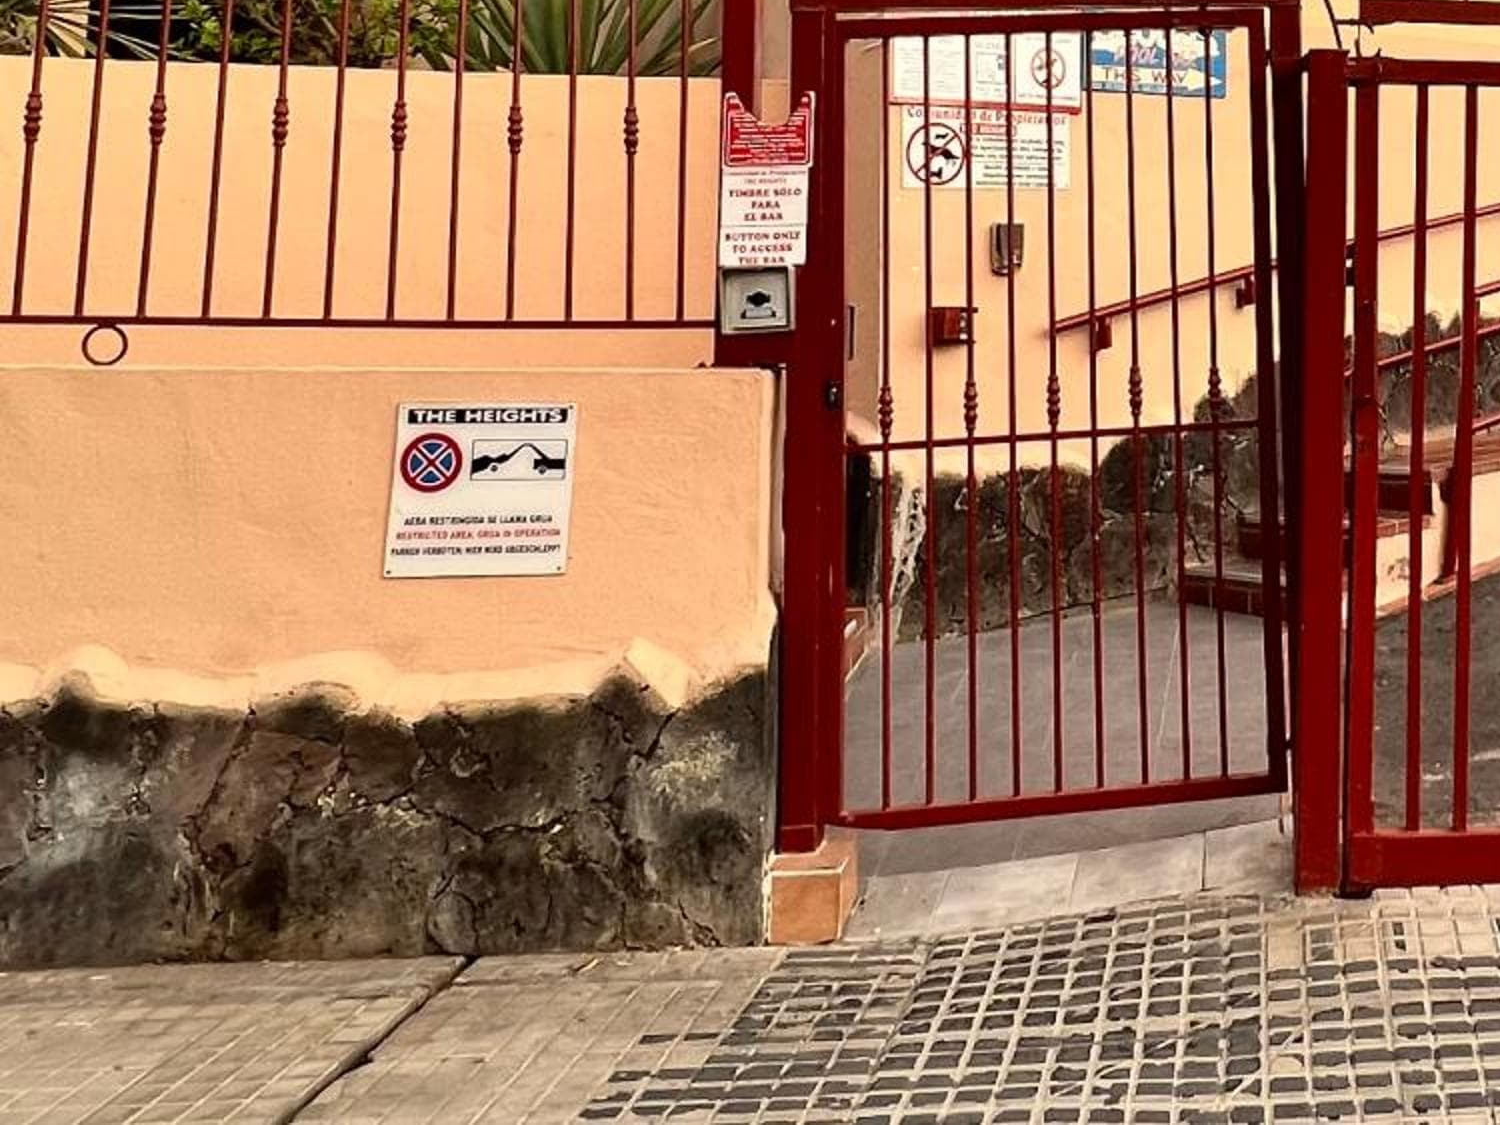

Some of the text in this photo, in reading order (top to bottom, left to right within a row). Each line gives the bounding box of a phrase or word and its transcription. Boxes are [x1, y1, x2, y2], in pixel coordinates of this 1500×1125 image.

[1103, 67, 1141, 82] THS
[907, 105, 977, 119] Counid
[729, 189, 769, 197] TIMBRE
[751, 201, 780, 209] PARA
[744, 213, 756, 221] EL
[725, 231, 801, 241] BUTTON ONLY
[733, 243, 793, 253] TO ACCESS
[413, 408, 563, 423] THE HEIGHTS
[396, 530, 449, 540] RESTRICTED
[514, 528, 561, 537] OPERATION
